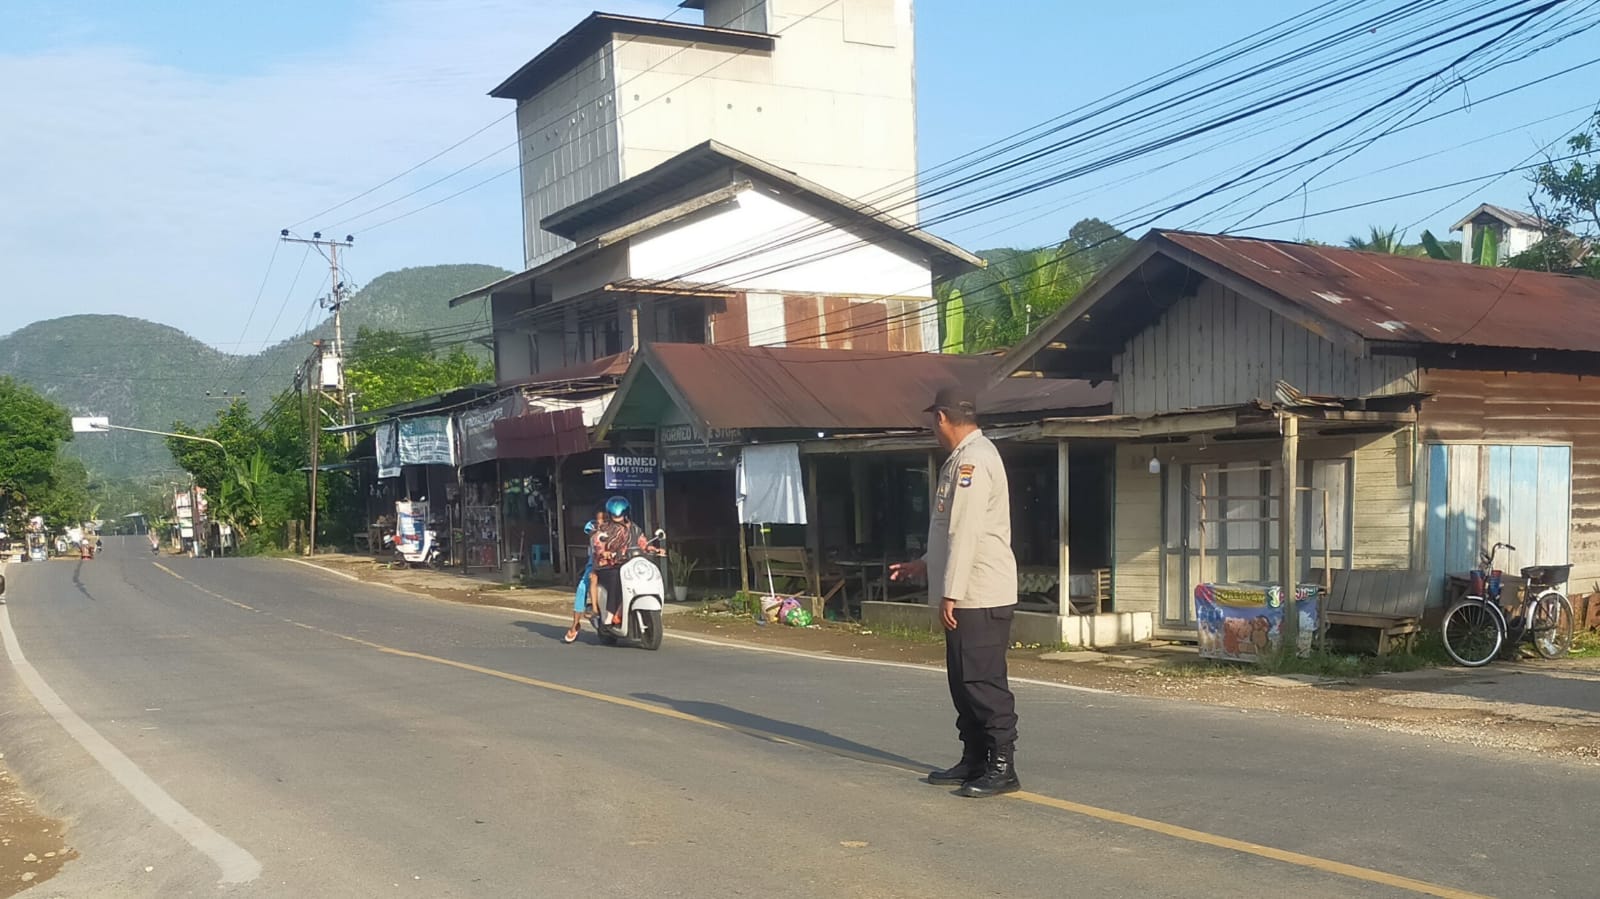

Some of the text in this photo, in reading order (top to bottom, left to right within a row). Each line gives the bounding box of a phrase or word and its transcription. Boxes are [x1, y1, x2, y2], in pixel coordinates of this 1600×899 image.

[661, 427, 691, 441] BORNEO
[608, 456, 656, 467] BORNEO
[611, 466, 653, 474] VAPE STORE
